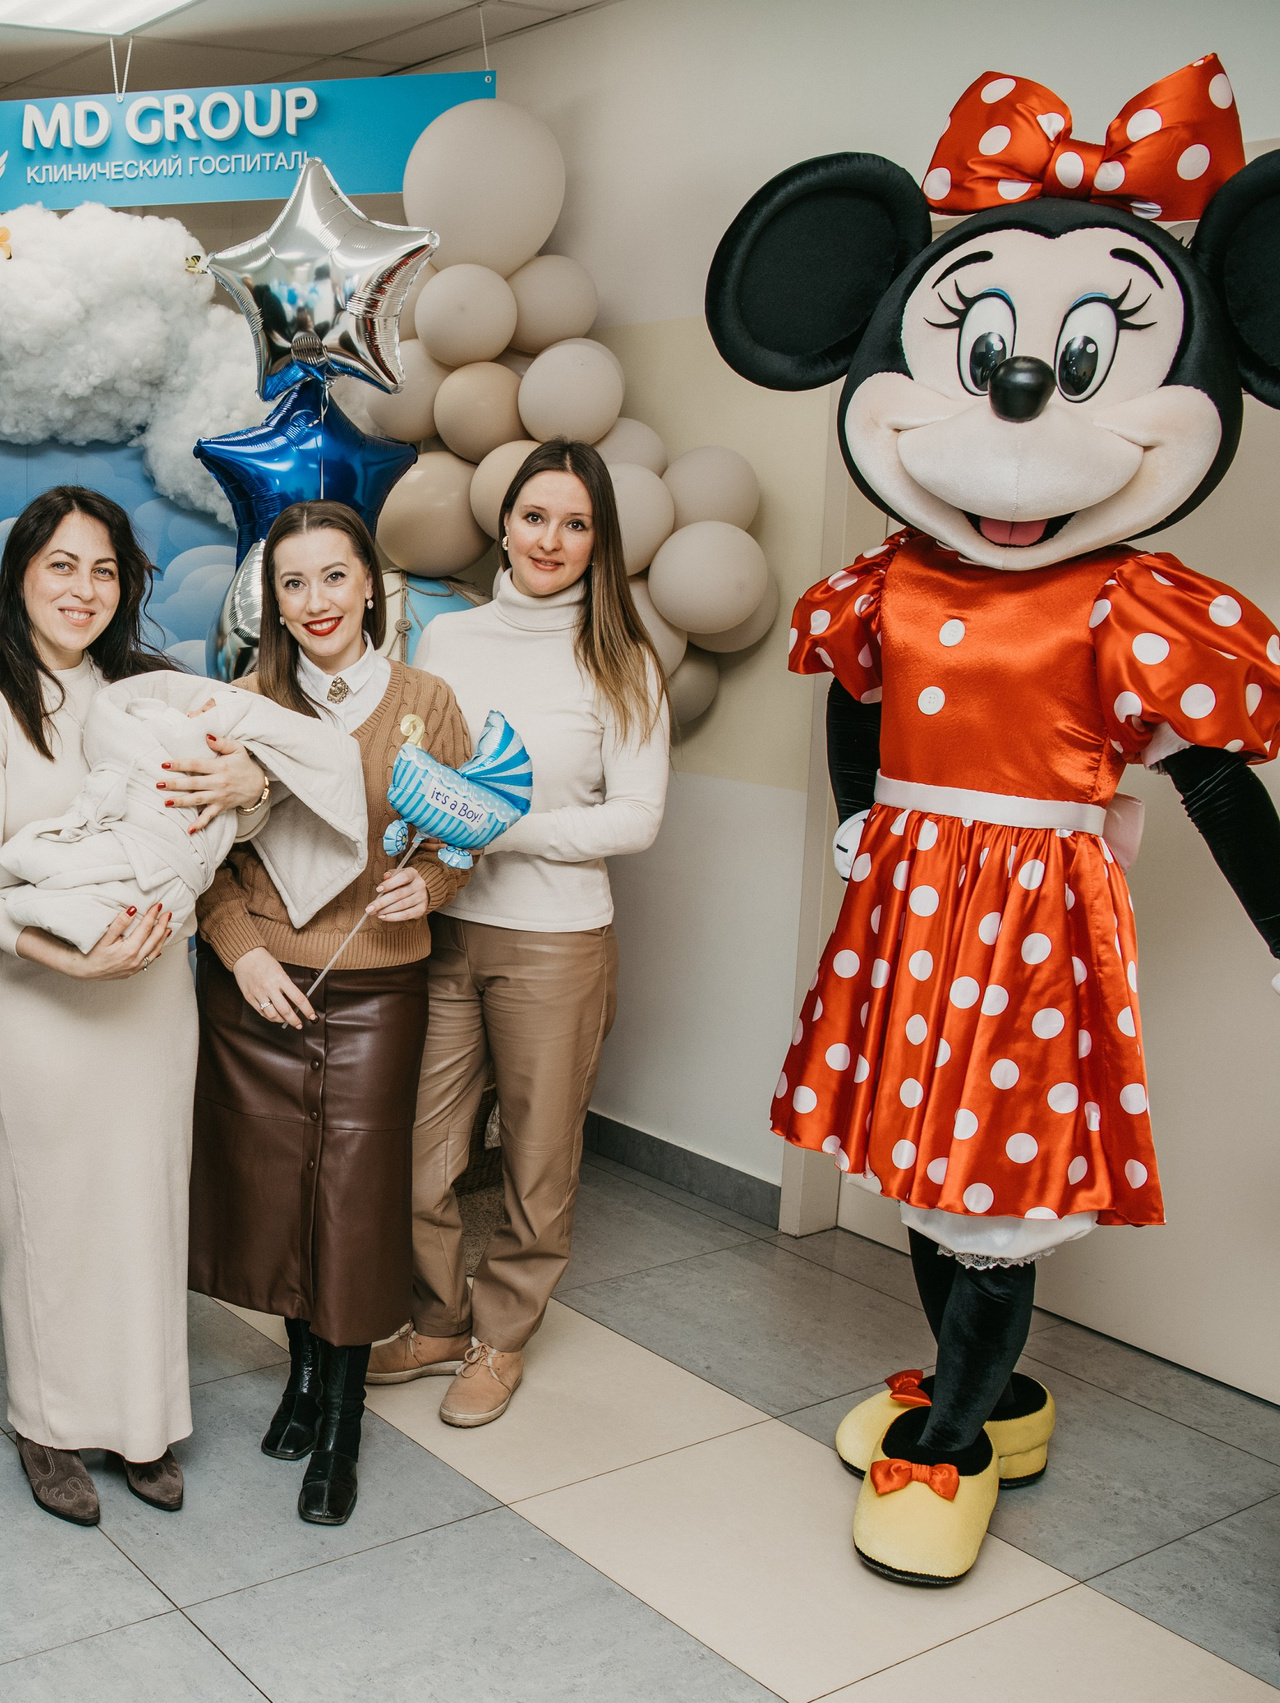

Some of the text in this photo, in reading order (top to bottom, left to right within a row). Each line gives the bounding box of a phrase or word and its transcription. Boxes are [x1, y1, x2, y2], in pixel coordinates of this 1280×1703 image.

[22, 87, 318, 150] MD GROUP
[26, 154, 182, 184] КЛИНИЧЕСКИЙ
[430, 787, 484, 823] it's a Boy!
